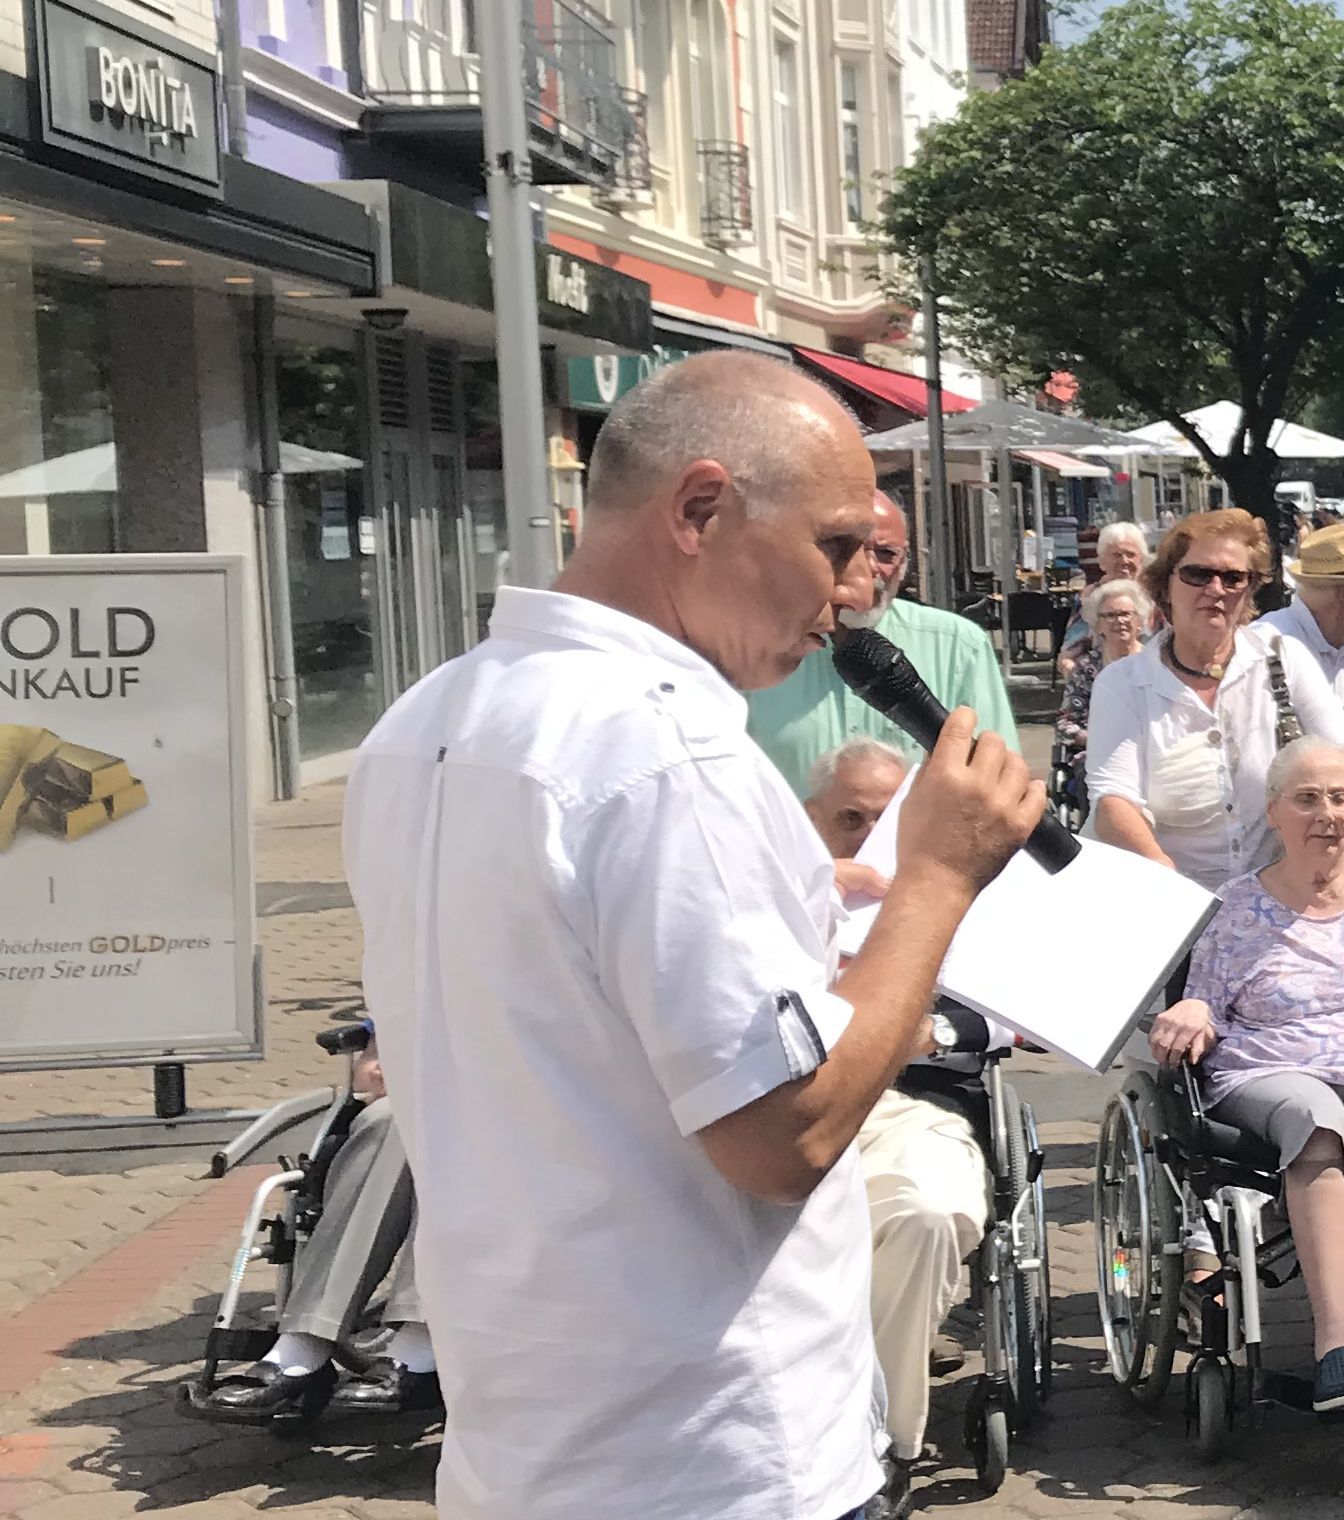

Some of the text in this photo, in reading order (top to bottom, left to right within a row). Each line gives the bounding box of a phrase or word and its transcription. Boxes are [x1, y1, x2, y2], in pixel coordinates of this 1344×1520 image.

[99, 46, 198, 139] BONITA
[51, 961, 84, 979] Sie
[91, 958, 141, 978] uns!
